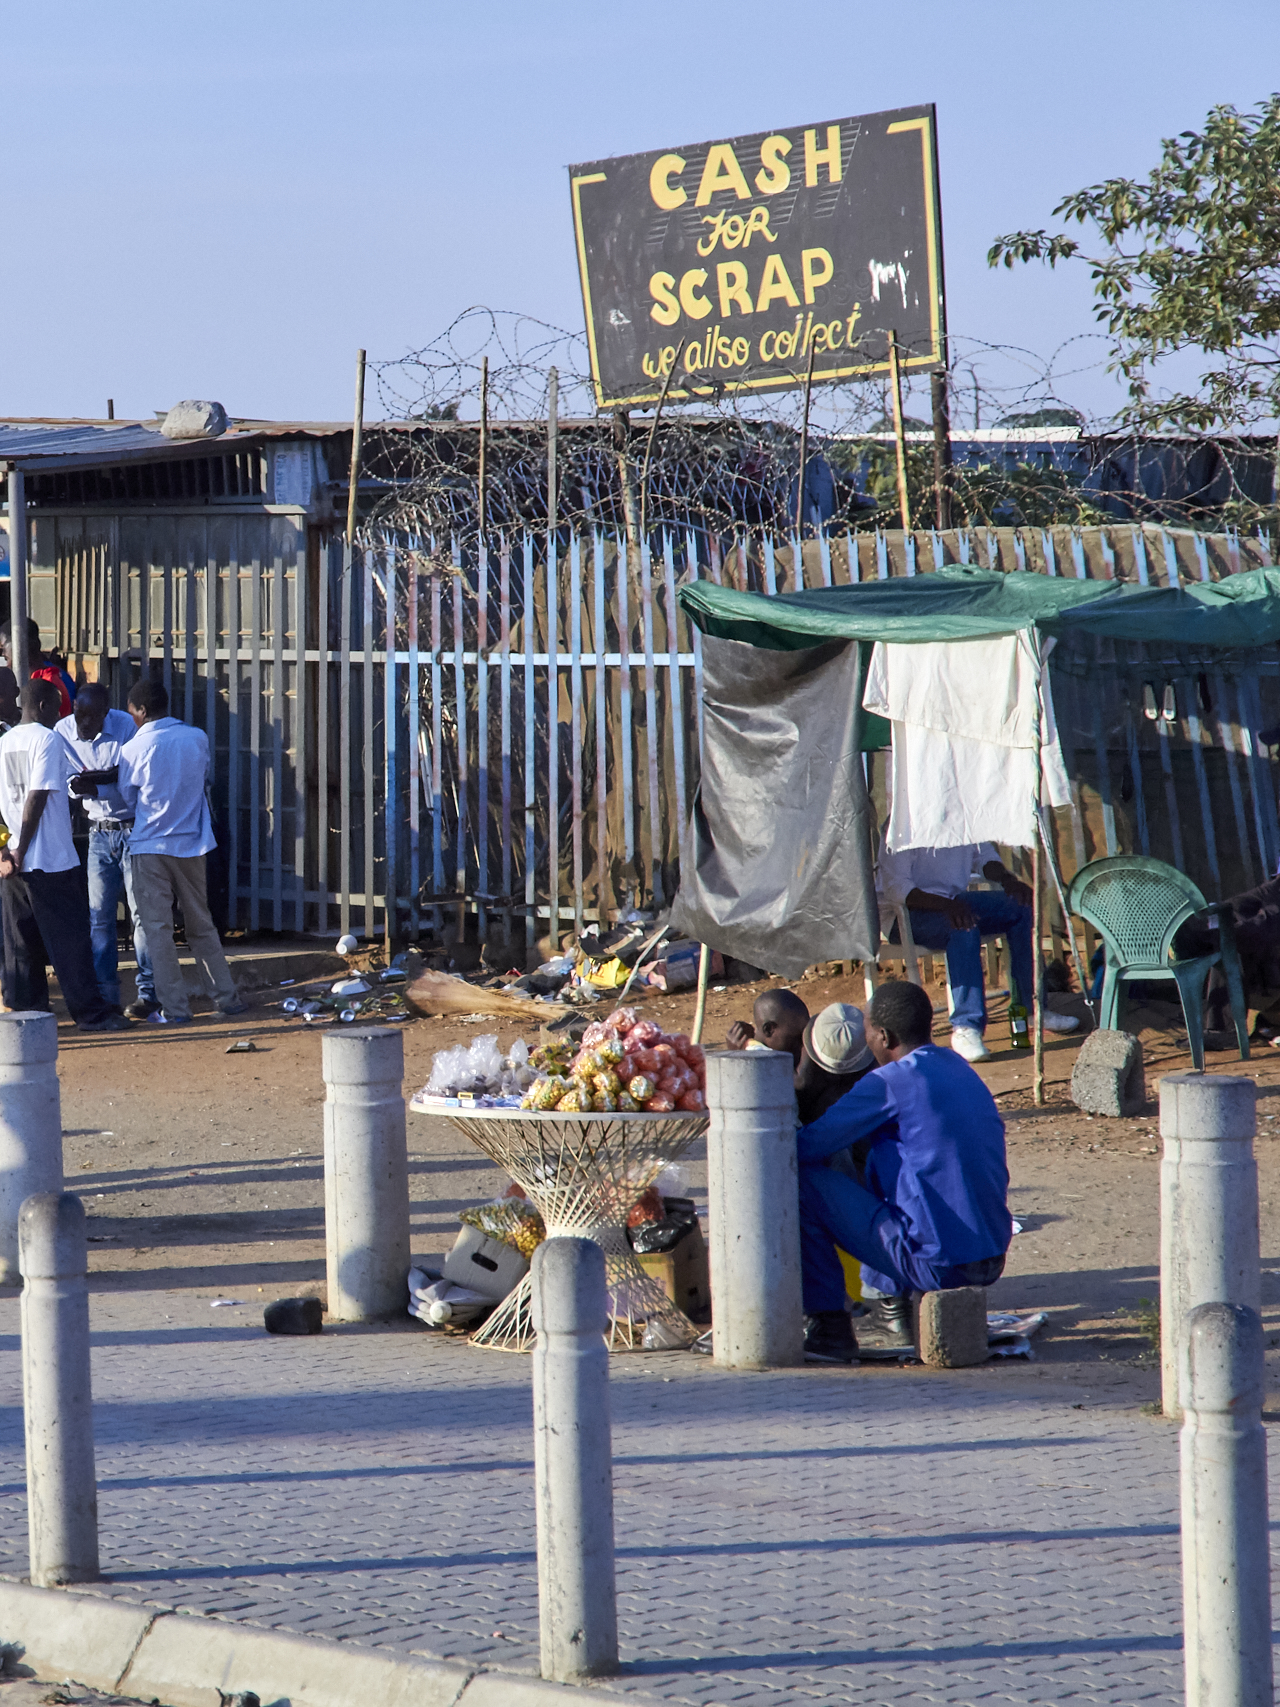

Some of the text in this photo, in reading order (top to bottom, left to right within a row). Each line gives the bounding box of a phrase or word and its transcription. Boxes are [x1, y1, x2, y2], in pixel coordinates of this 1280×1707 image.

[649, 124, 842, 211] CASH
[649, 247, 835, 326] SCRAP
[642, 345, 676, 379] we
[759, 302, 862, 362] collect
